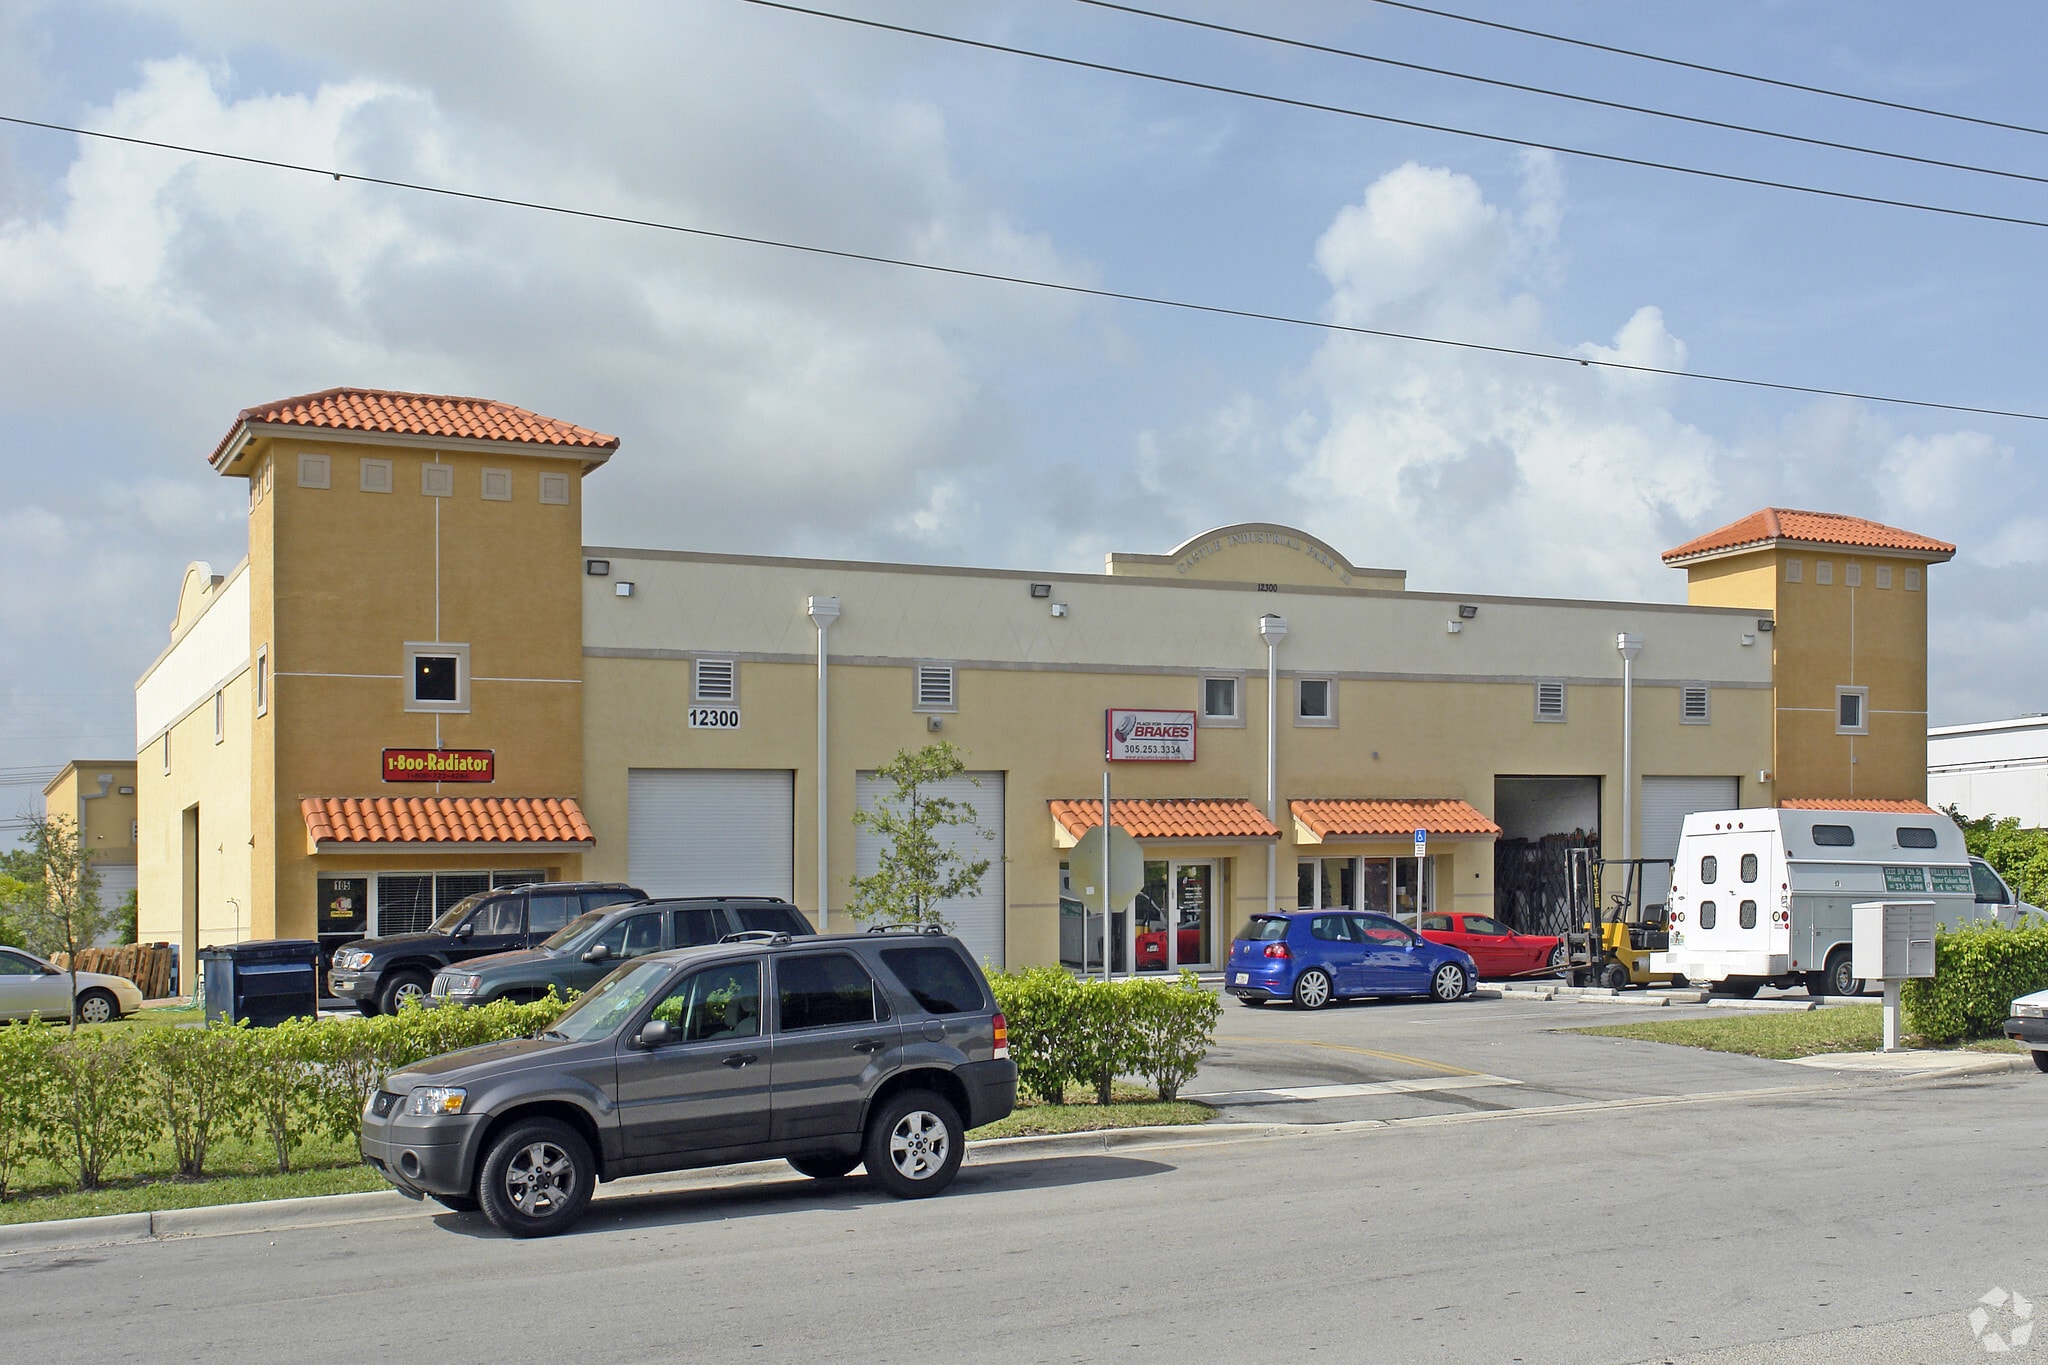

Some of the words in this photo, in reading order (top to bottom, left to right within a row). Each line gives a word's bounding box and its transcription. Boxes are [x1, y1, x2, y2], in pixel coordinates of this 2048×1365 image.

[1177, 540, 1222, 574] CASTLE
[1227, 532, 1301, 551] INDUSTRIAL
[1305, 544, 1336, 572] PARK
[1257, 583, 1278, 593] 12300
[689, 709, 739, 727] 12300
[1134, 726, 1190, 738] BRAKES
[1124, 744, 1181, 754] 305.253.3334
[334, 880, 350, 890] 105
[1592, 863, 1601, 909] HYSTER
